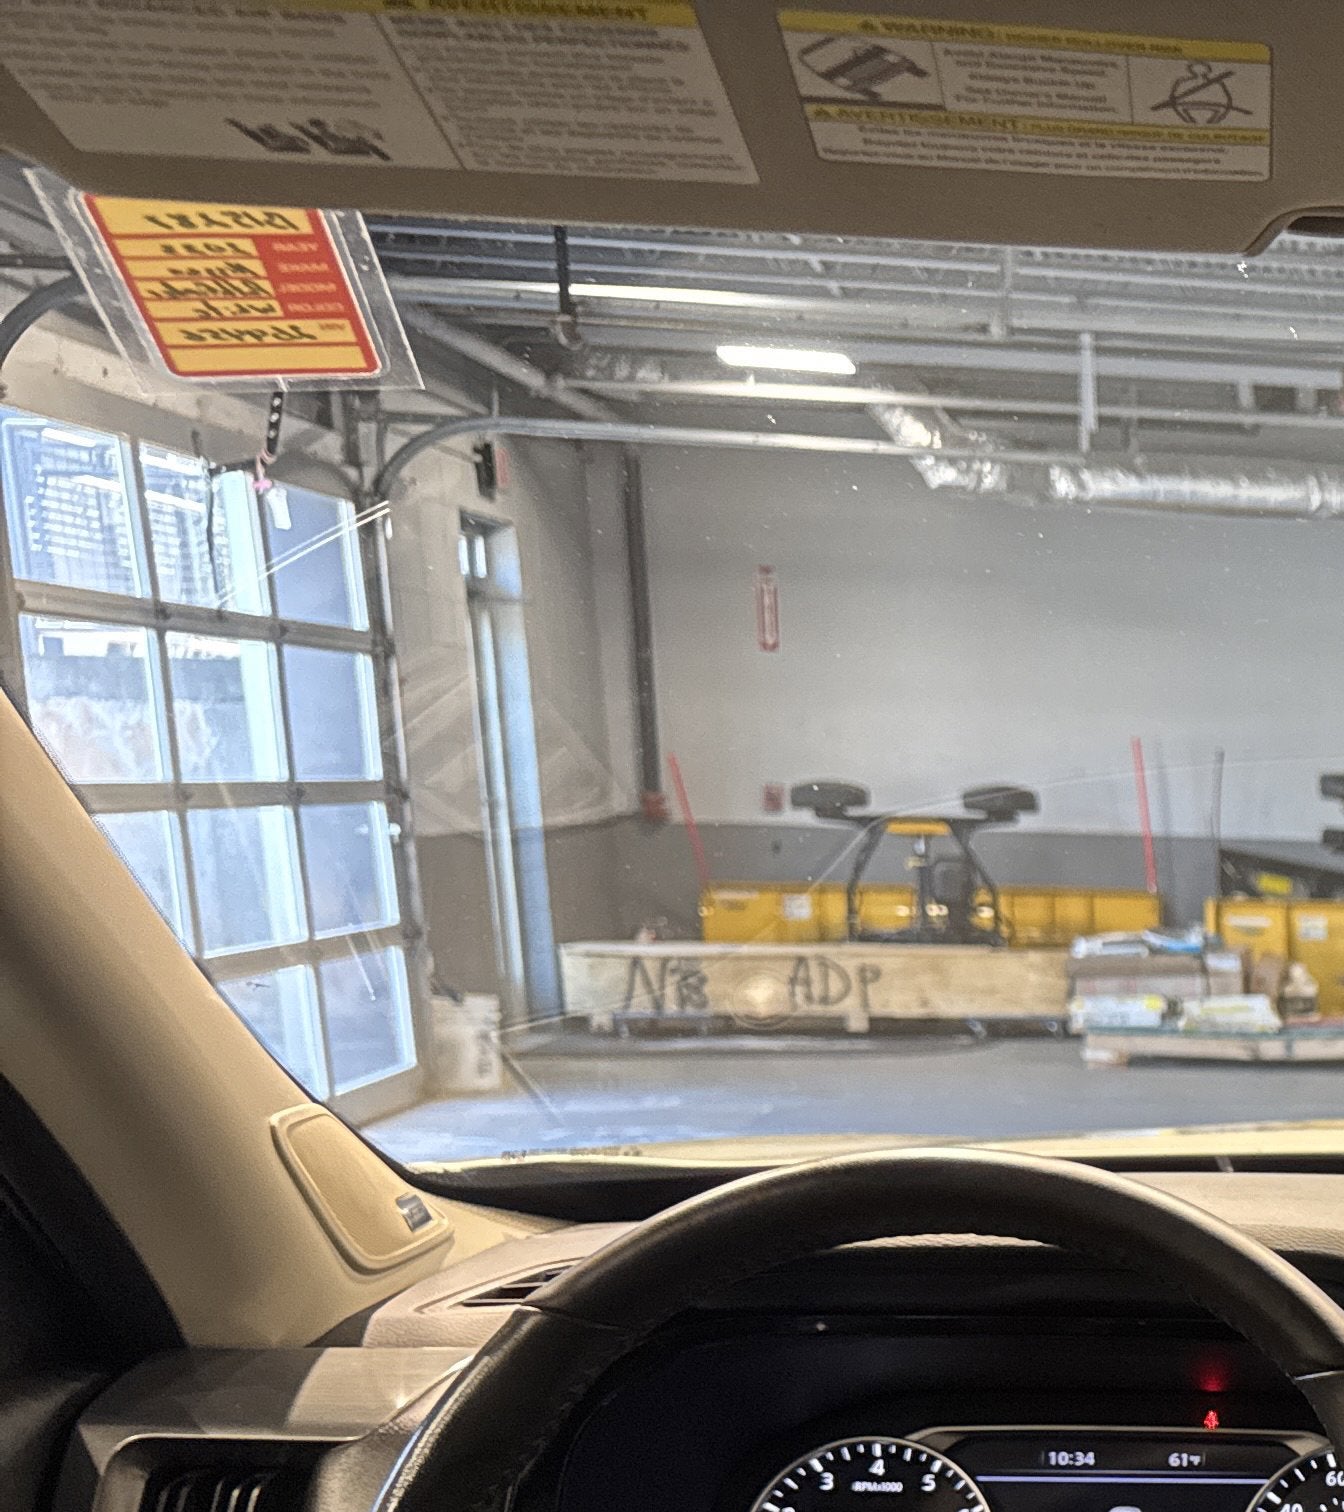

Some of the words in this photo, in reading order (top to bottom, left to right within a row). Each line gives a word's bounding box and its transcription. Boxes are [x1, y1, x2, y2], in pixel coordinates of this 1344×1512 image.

[788, 956, 880, 1006] ADP
[869, 1458, 886, 1476] 4
[1048, 1451, 1095, 1466] 10:34
[819, 1472, 834, 1491] 3
[920, 1473, 937, 1492] 5
